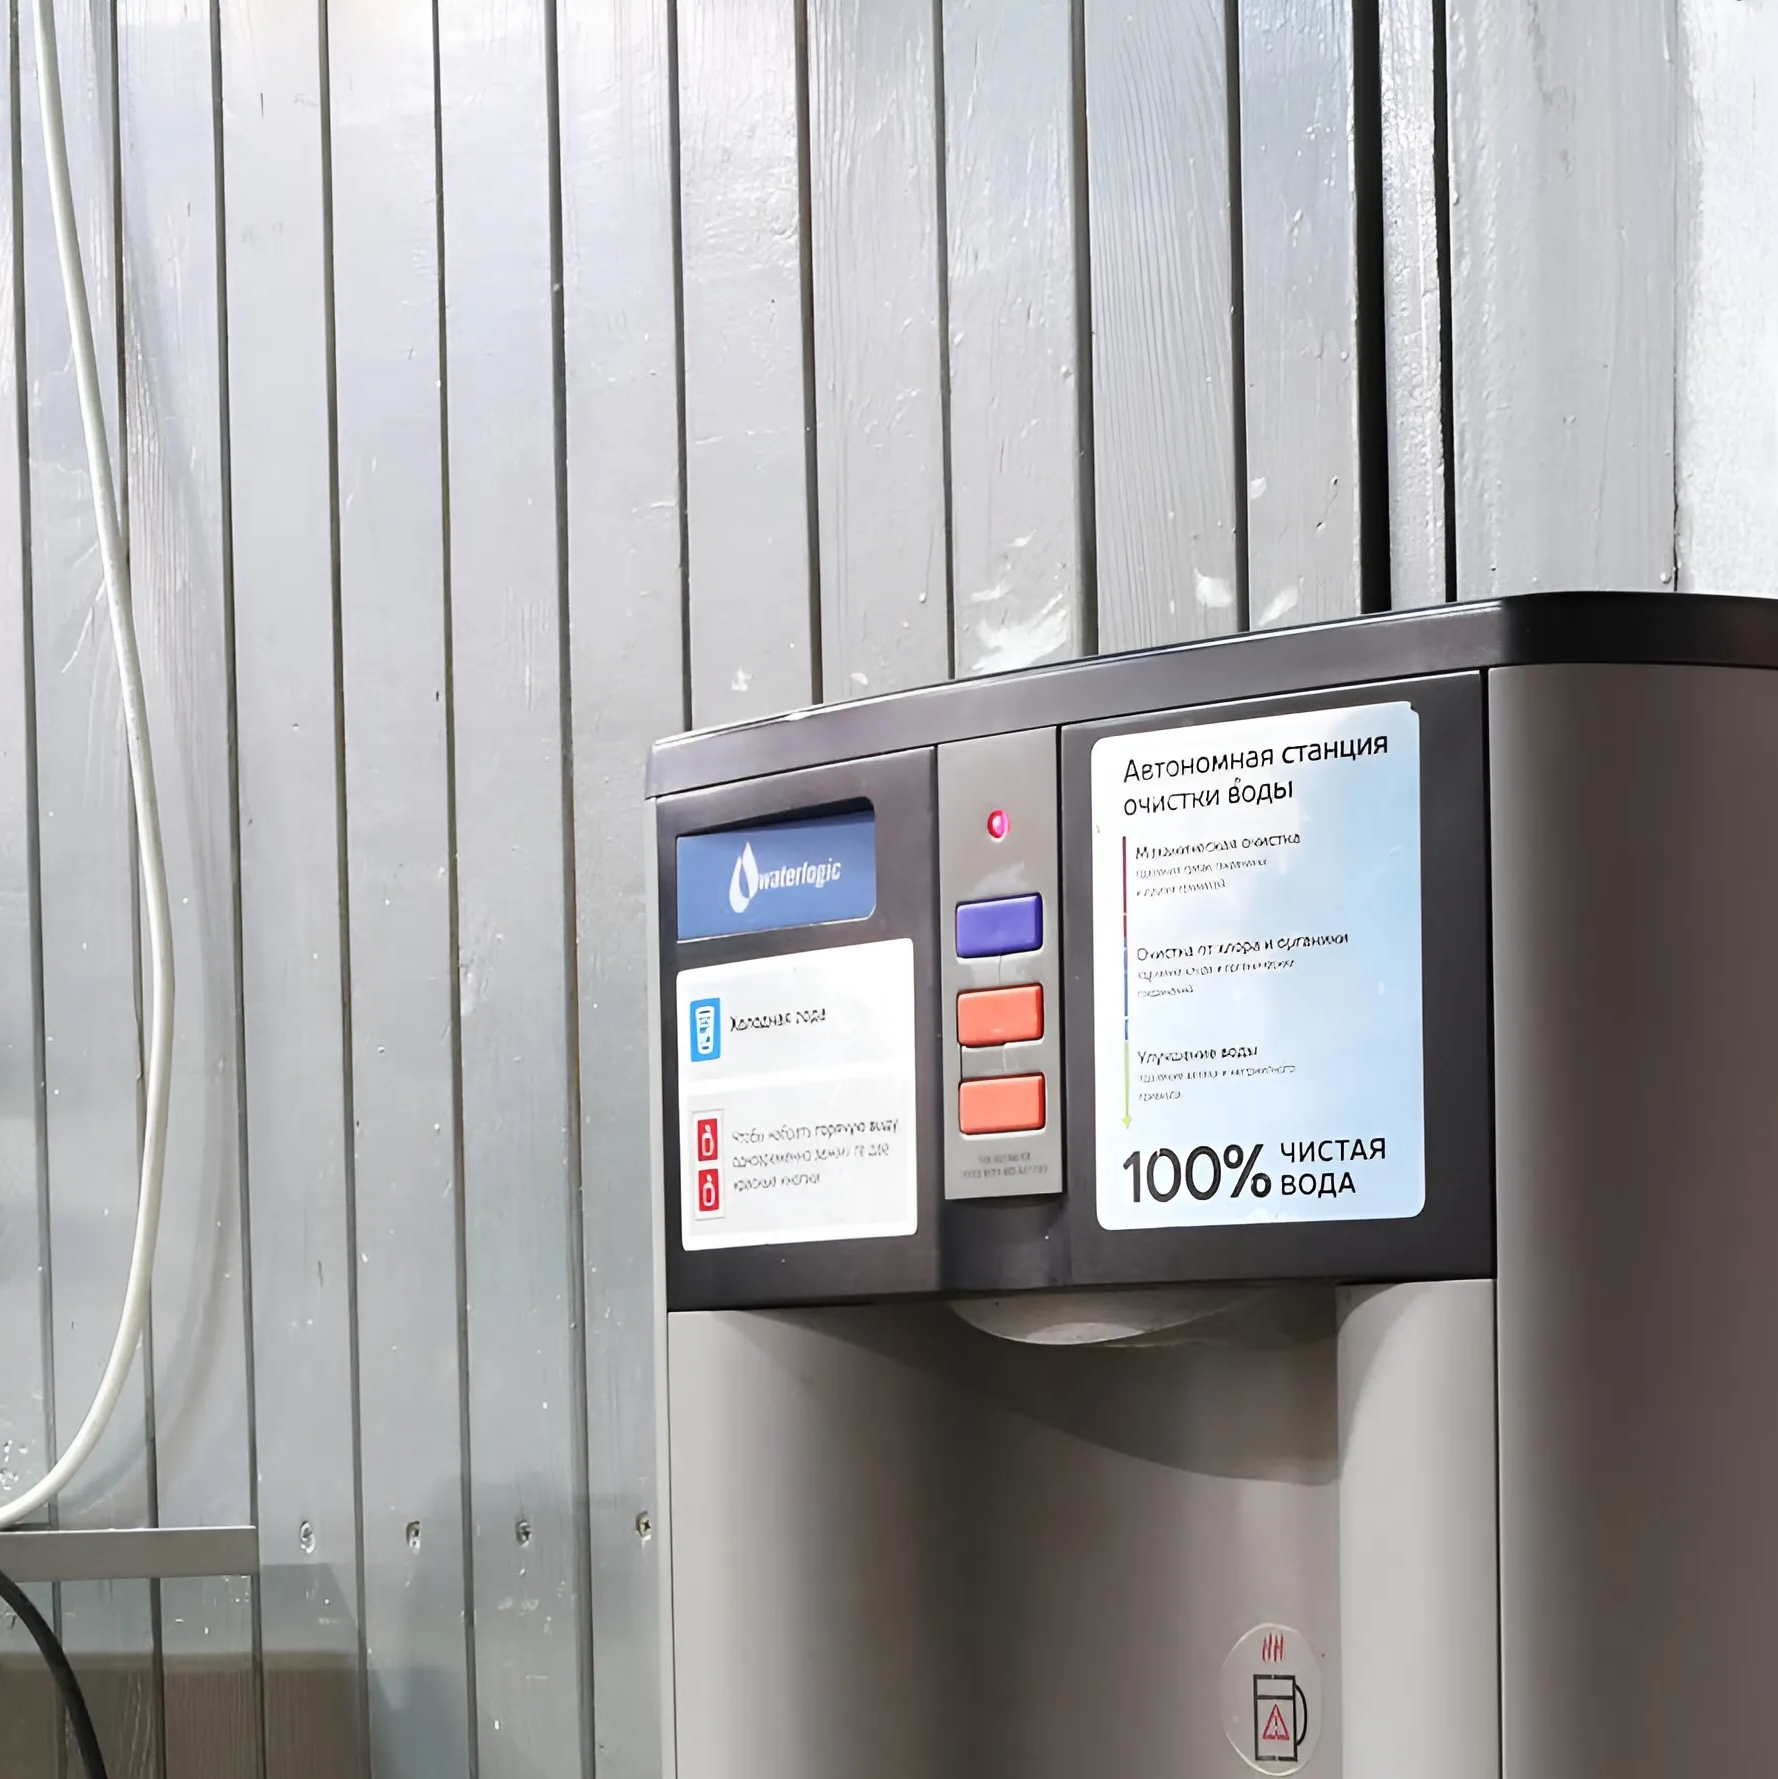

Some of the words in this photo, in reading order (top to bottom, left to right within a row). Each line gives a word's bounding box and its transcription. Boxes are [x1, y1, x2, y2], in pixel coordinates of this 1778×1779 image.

[1124, 748, 1273, 782] Автономная
[1282, 735, 1388, 764] станция
[1124, 788, 1220, 816] очистки
[1229, 778, 1293, 805] воды
[758, 858, 841, 889] waterlogic
[1280, 1137, 1386, 1163] ЧИСТАЯ
[1123, 1144, 1272, 1203] 100%
[1281, 1172, 1356, 1199] ВОДА
